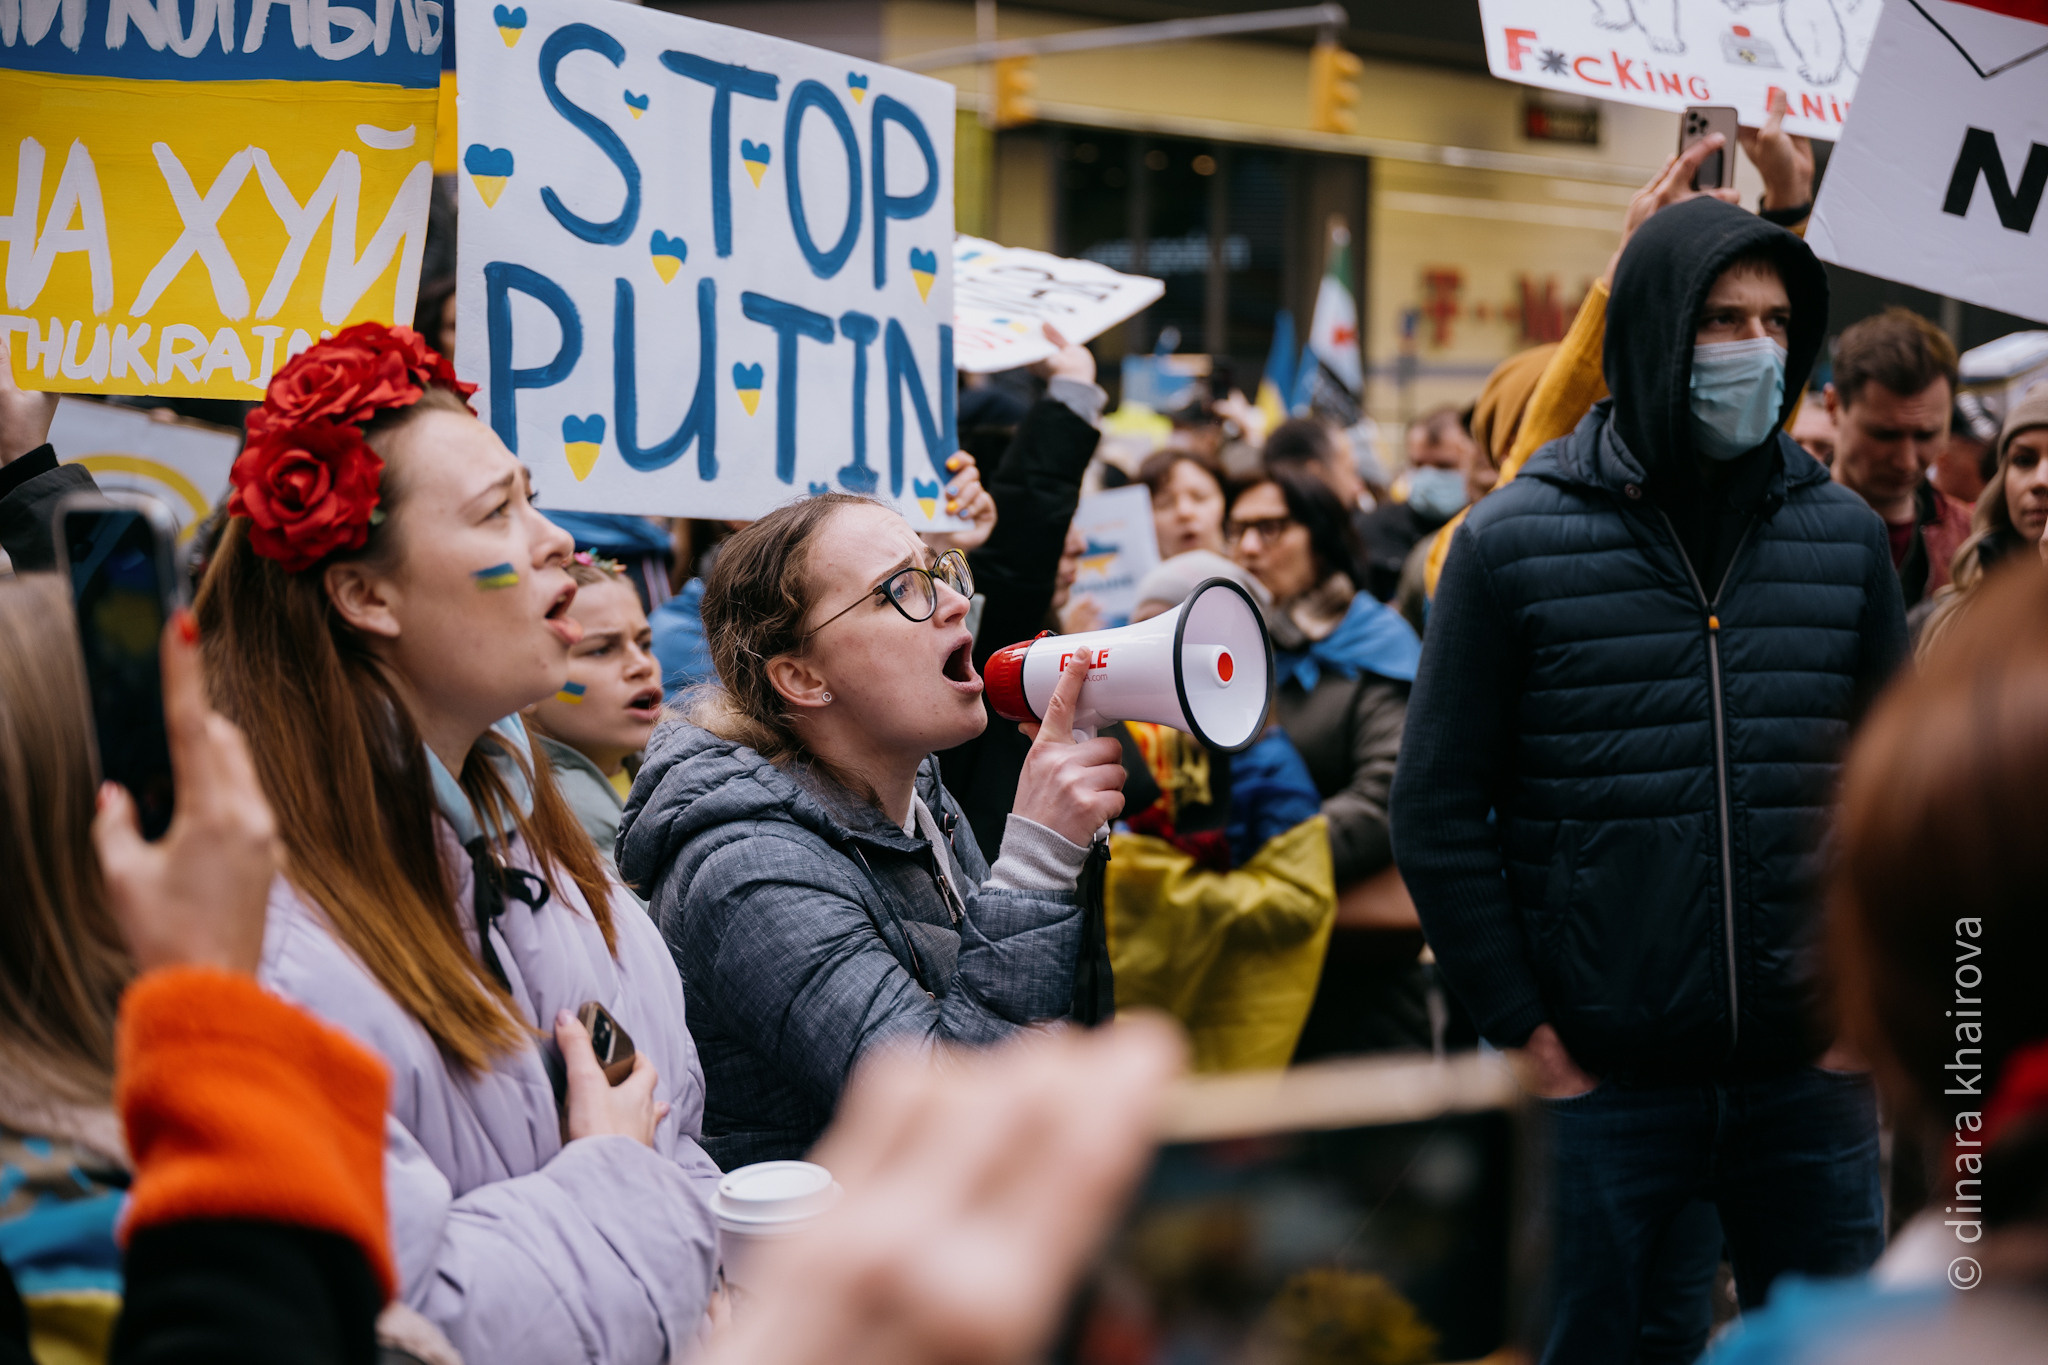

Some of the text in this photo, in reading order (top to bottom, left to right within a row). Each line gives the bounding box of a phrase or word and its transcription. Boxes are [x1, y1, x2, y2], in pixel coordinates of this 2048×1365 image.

[0, 124, 434, 326] НА ХУЙ
[539, 23, 939, 290] STOP
[484, 261, 959, 498] PUTIN
[1060, 648, 1109, 672] PLE
